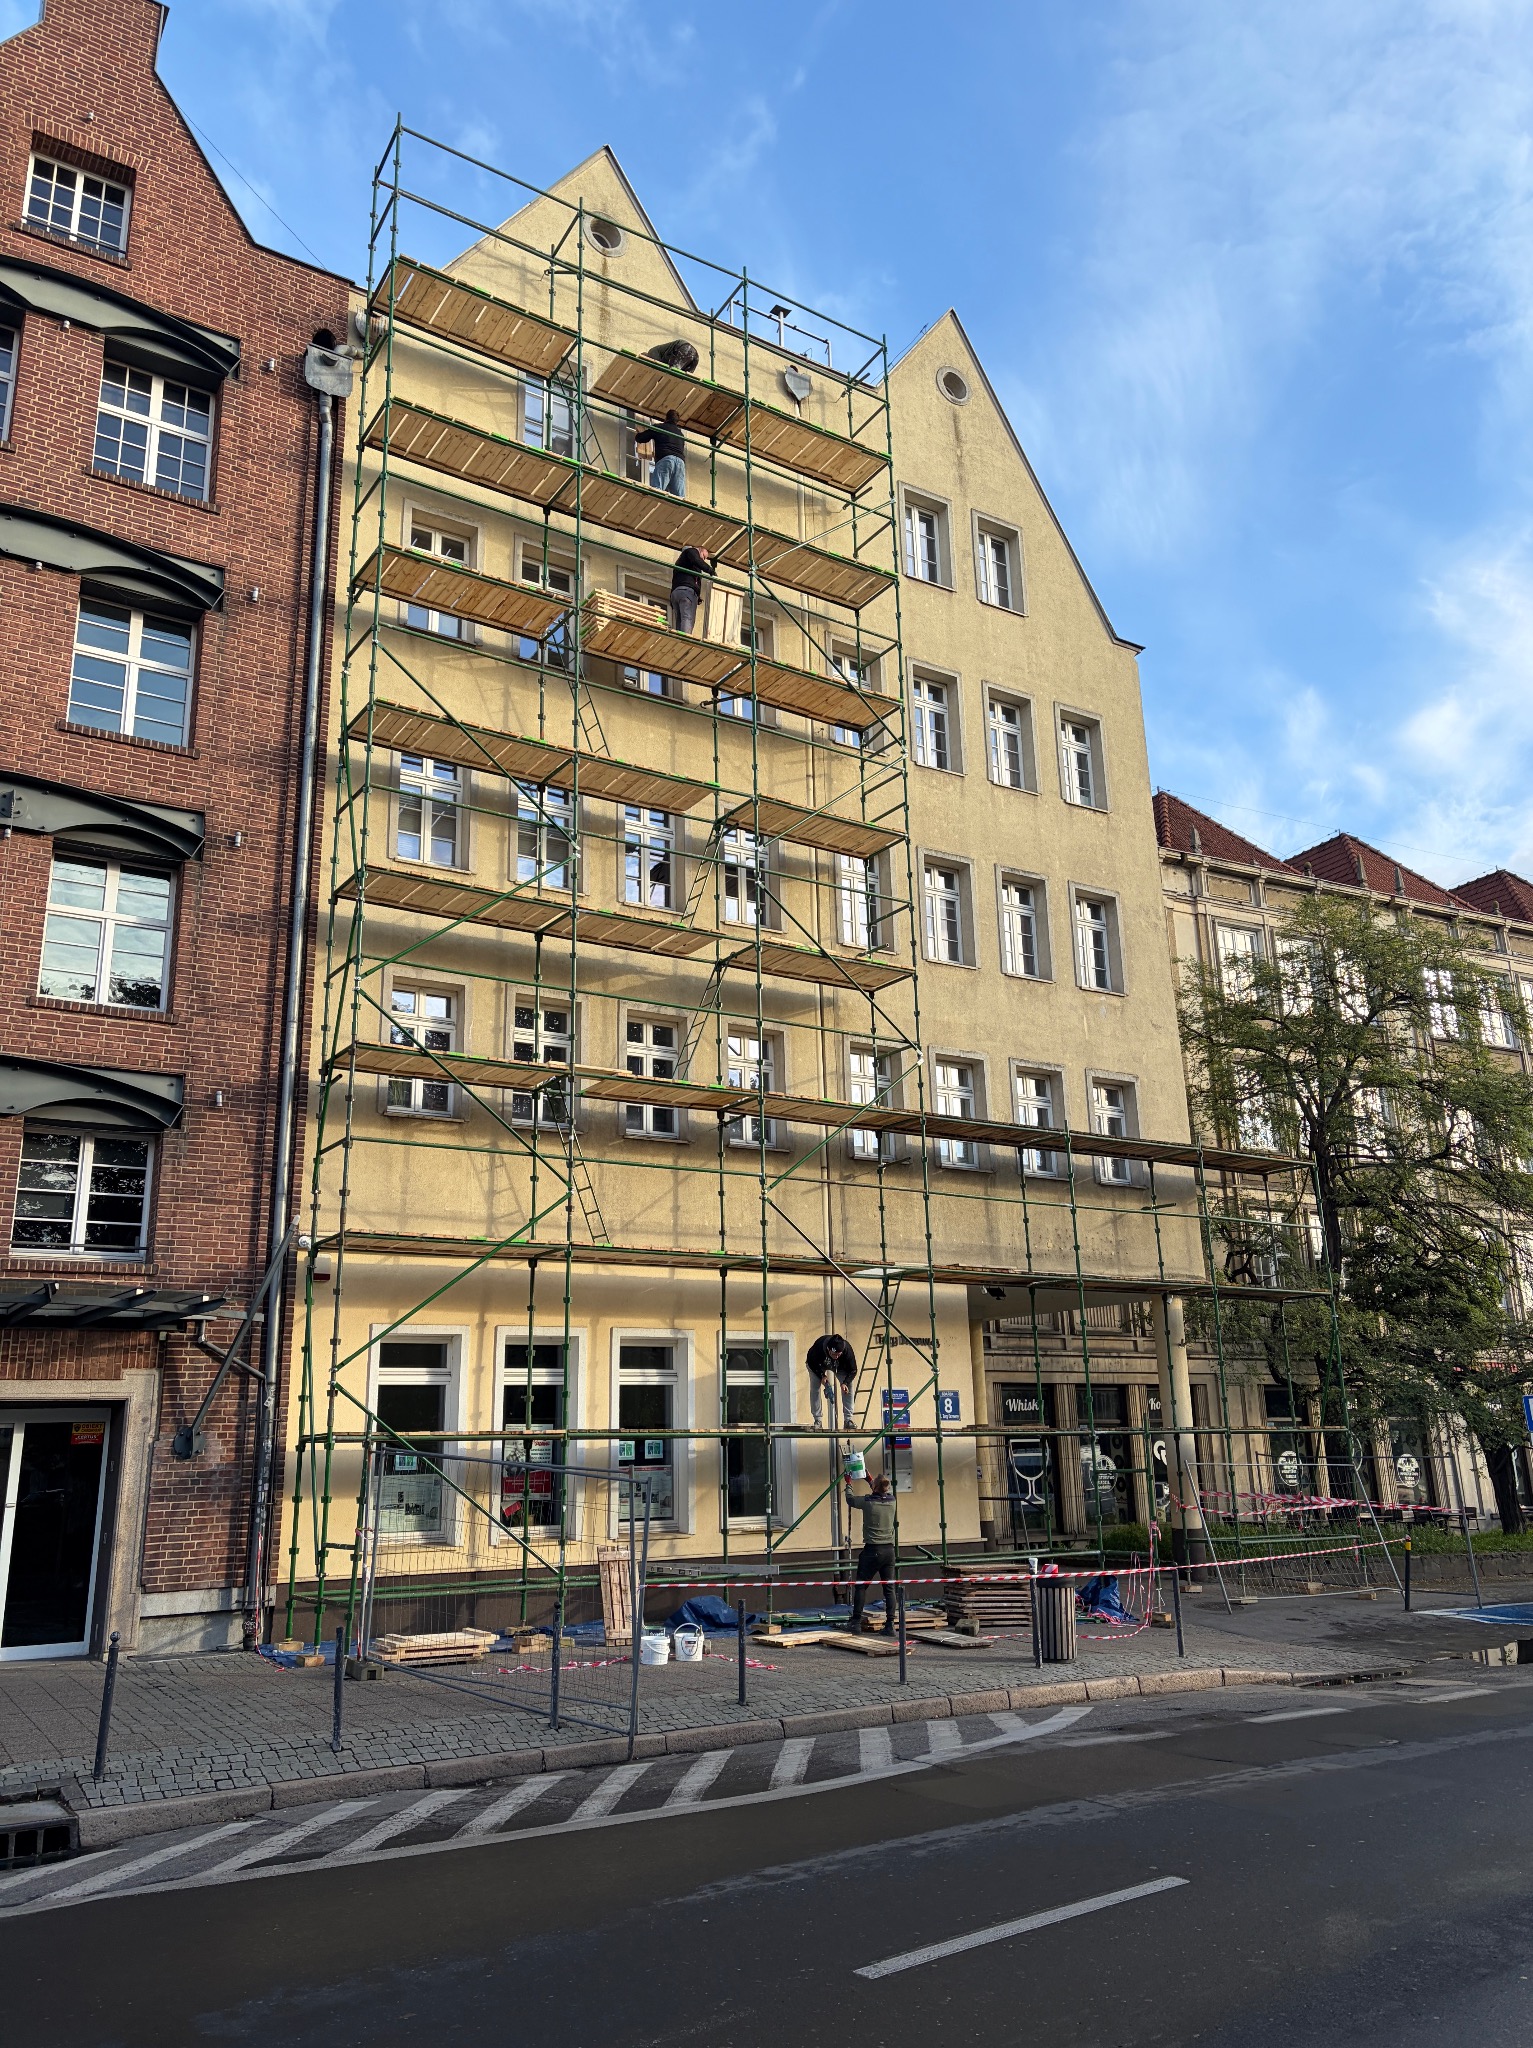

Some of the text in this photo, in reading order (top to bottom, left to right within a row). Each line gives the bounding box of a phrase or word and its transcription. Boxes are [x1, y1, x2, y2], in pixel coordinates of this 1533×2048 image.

[944, 1398, 953, 1413] 8
[1005, 1399, 1041, 1412] Whisk
[1148, 1398, 1161, 1410] Ko
